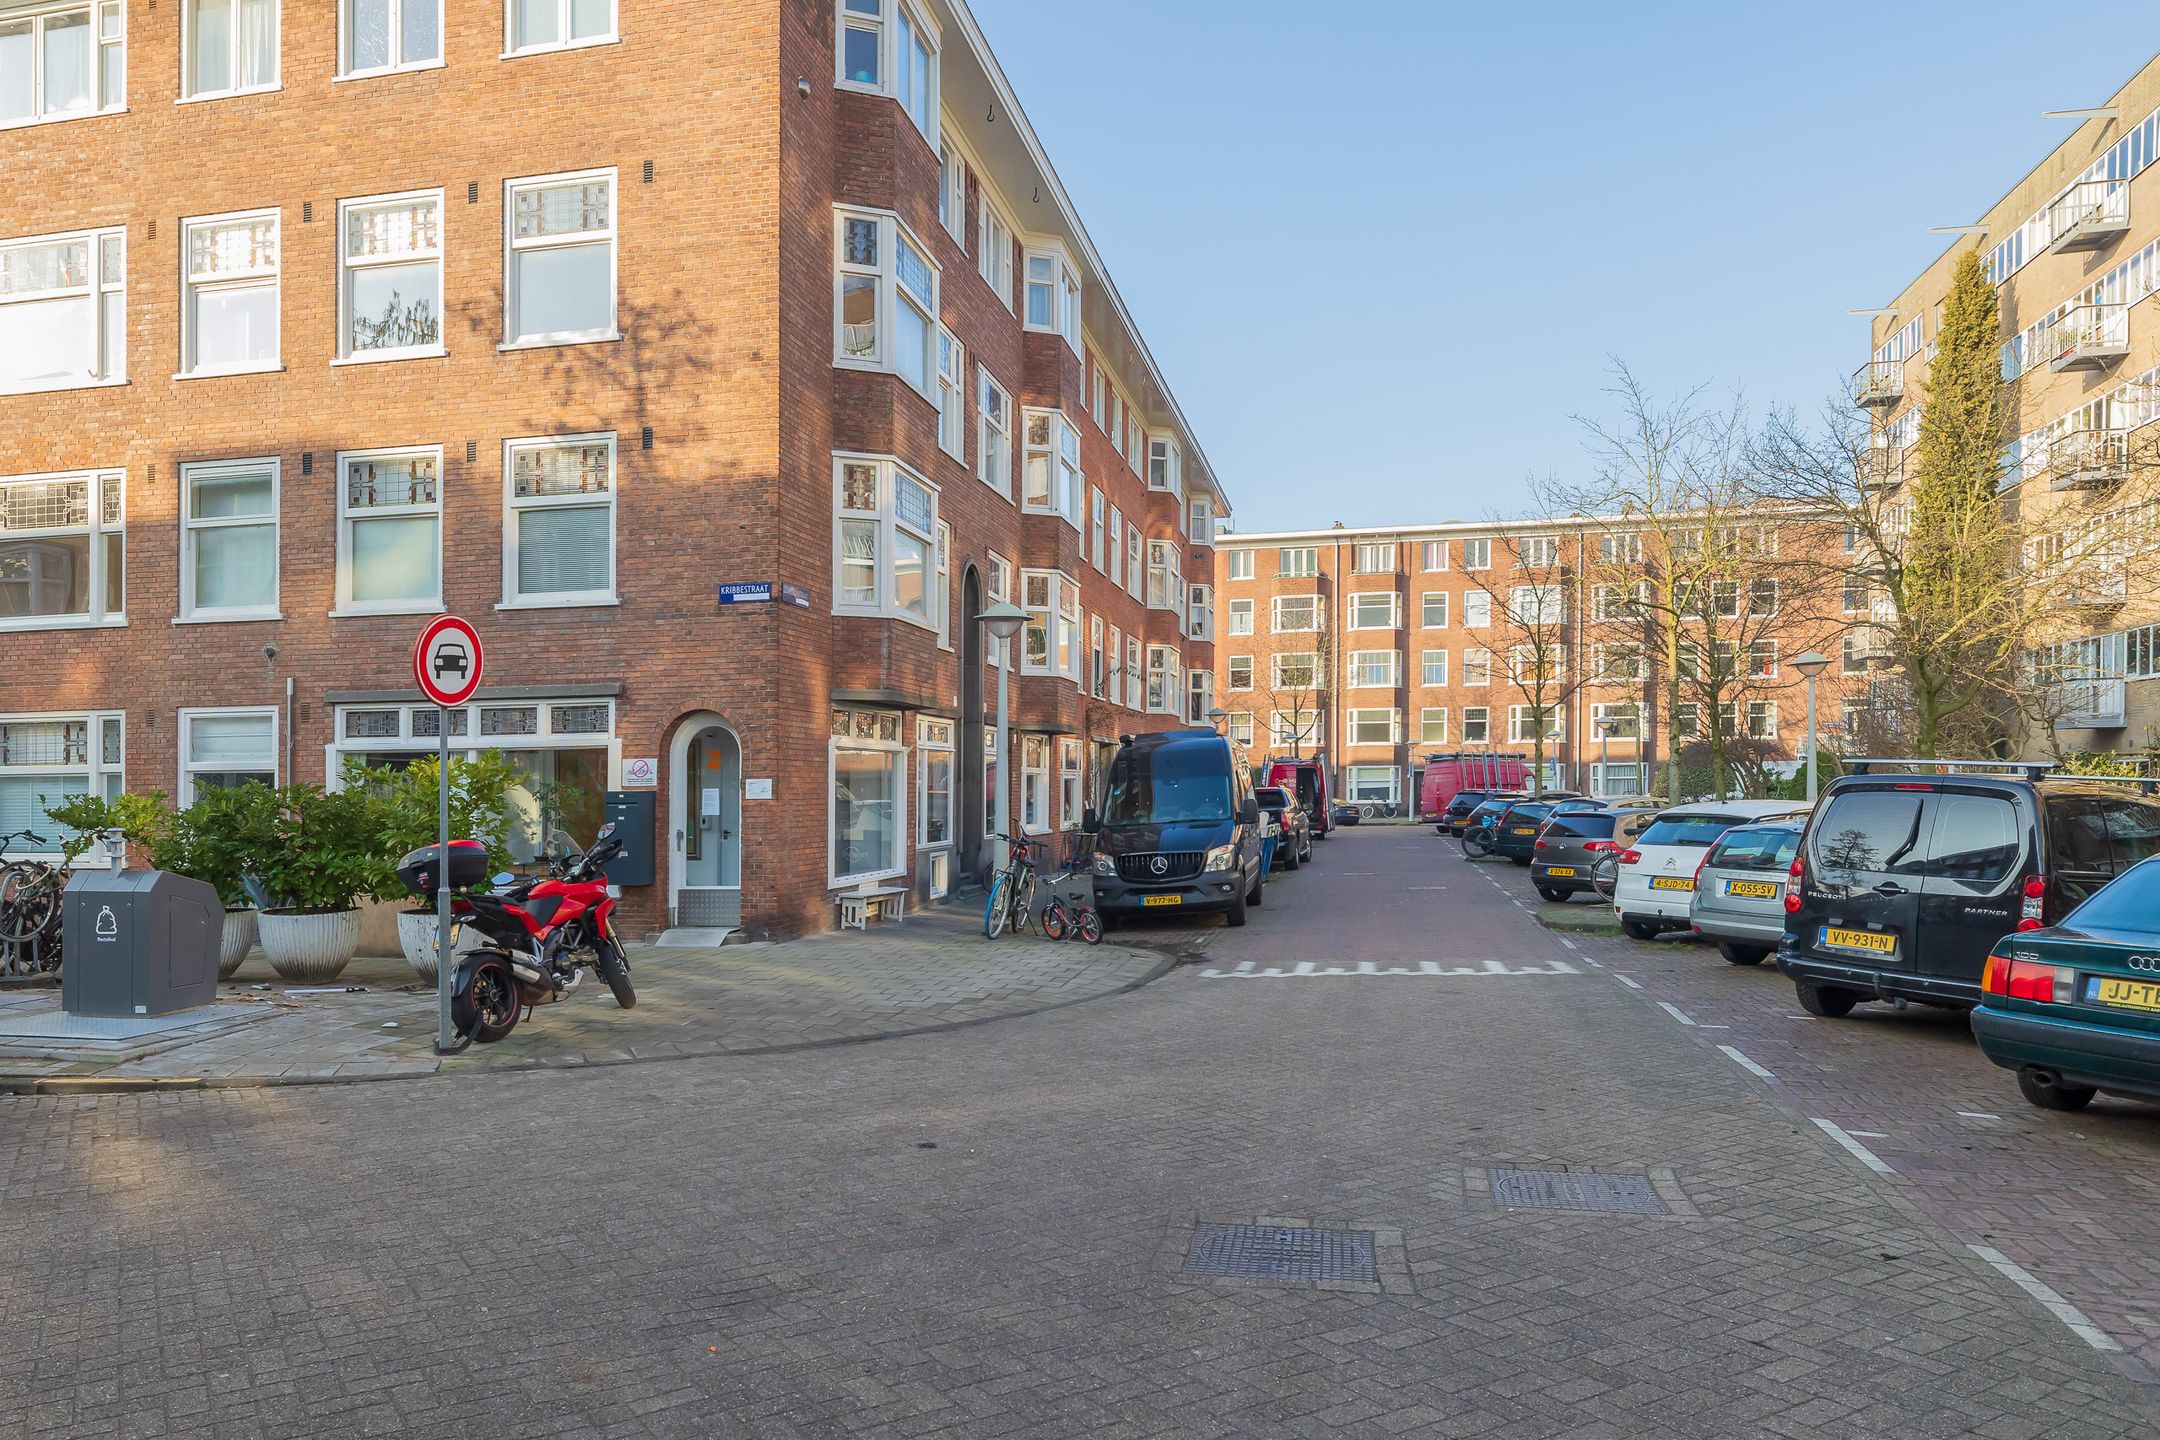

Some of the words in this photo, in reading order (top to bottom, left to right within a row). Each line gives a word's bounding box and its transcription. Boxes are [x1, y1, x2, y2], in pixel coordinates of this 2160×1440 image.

[720, 584, 768, 595] KRIBBESTRAAT
[706, 751, 721, 769] 2
[1656, 879, 1690, 889] 4-SJD-74
[1732, 883, 1773, 895] X-055-SV
[1145, 896, 1179, 904] V-977-HG
[1807, 891, 1843, 900] PEUGEOT
[1964, 907, 2008, 917] PARTNER
[1833, 931, 1888, 949] VV-931-N
